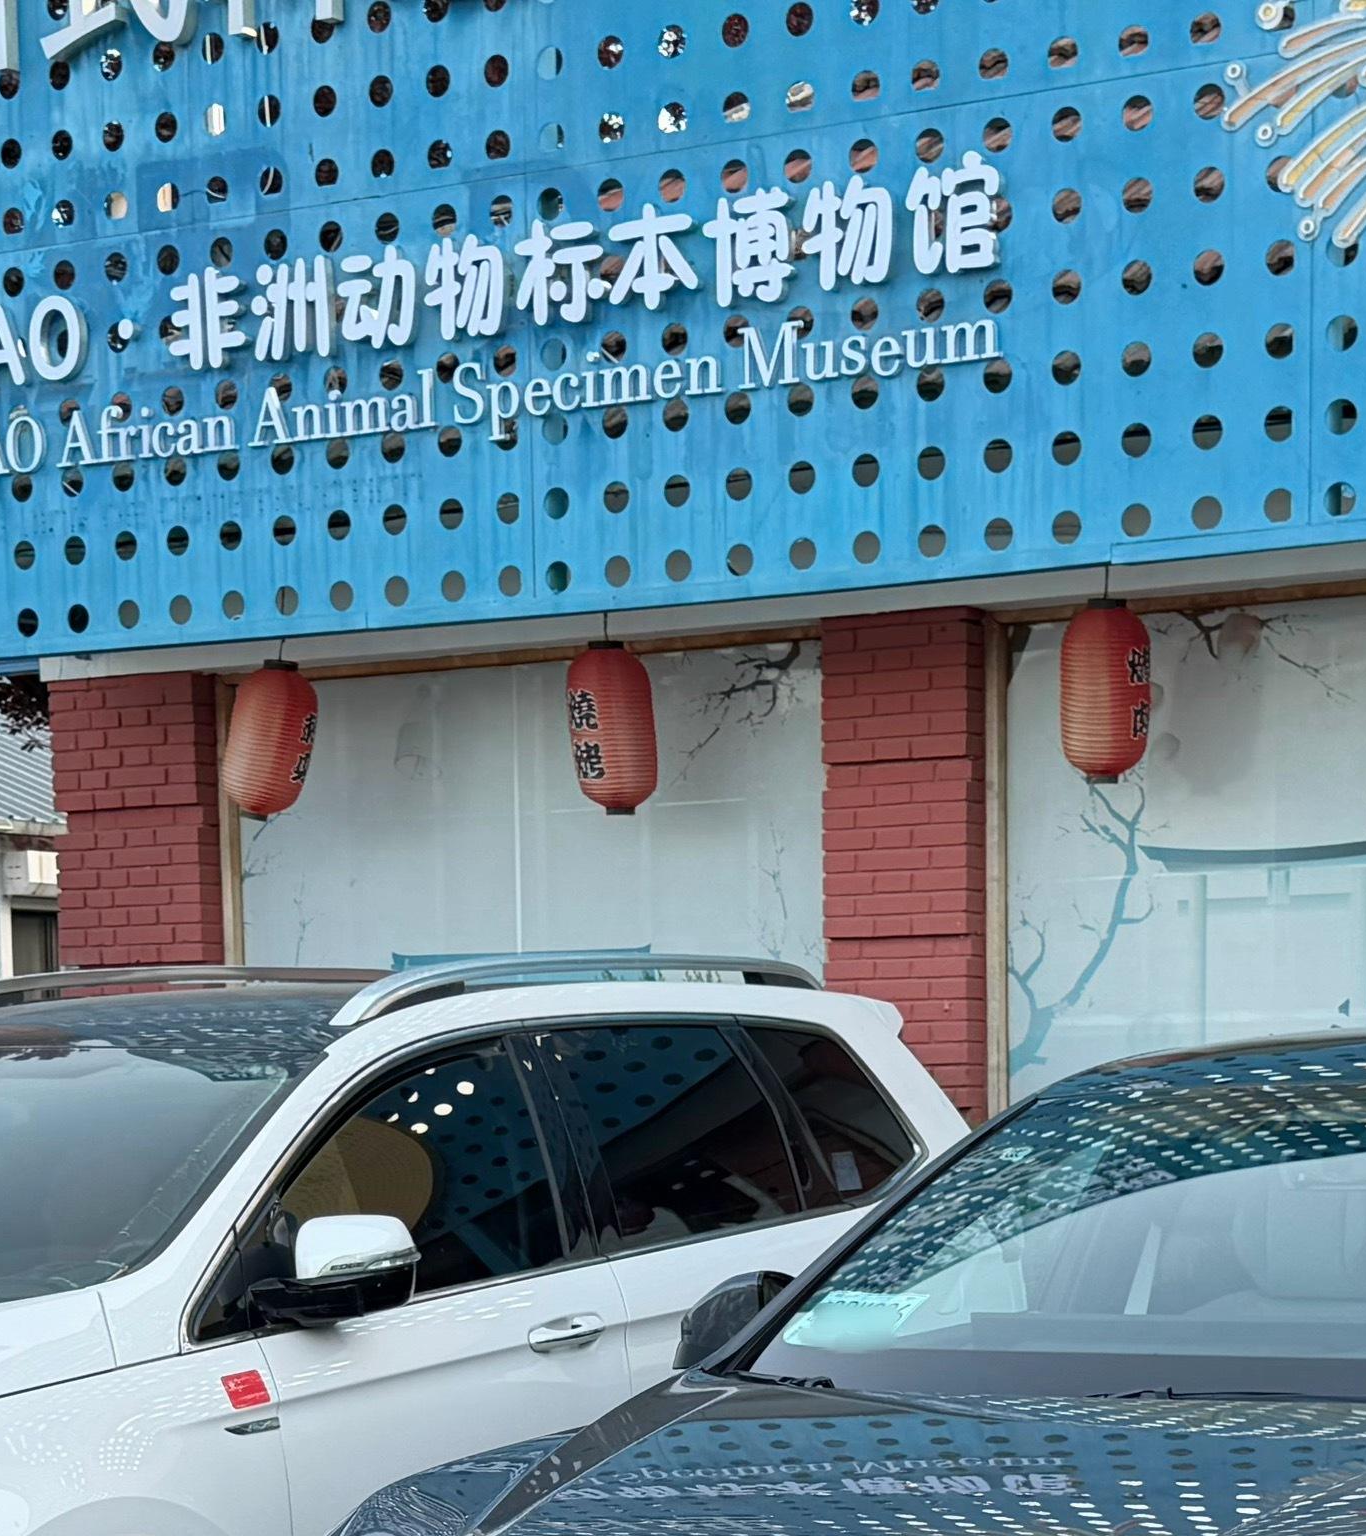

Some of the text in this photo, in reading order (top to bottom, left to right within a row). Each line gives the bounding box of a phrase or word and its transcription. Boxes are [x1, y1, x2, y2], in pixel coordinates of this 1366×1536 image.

[168, 150, 1003, 371] 非洲动物标本博物馆
[58, 406, 238, 467] African
[246, 369, 436, 447] Animal
[452, 350, 723, 442] Specimen
[738, 316, 999, 390] Museum
